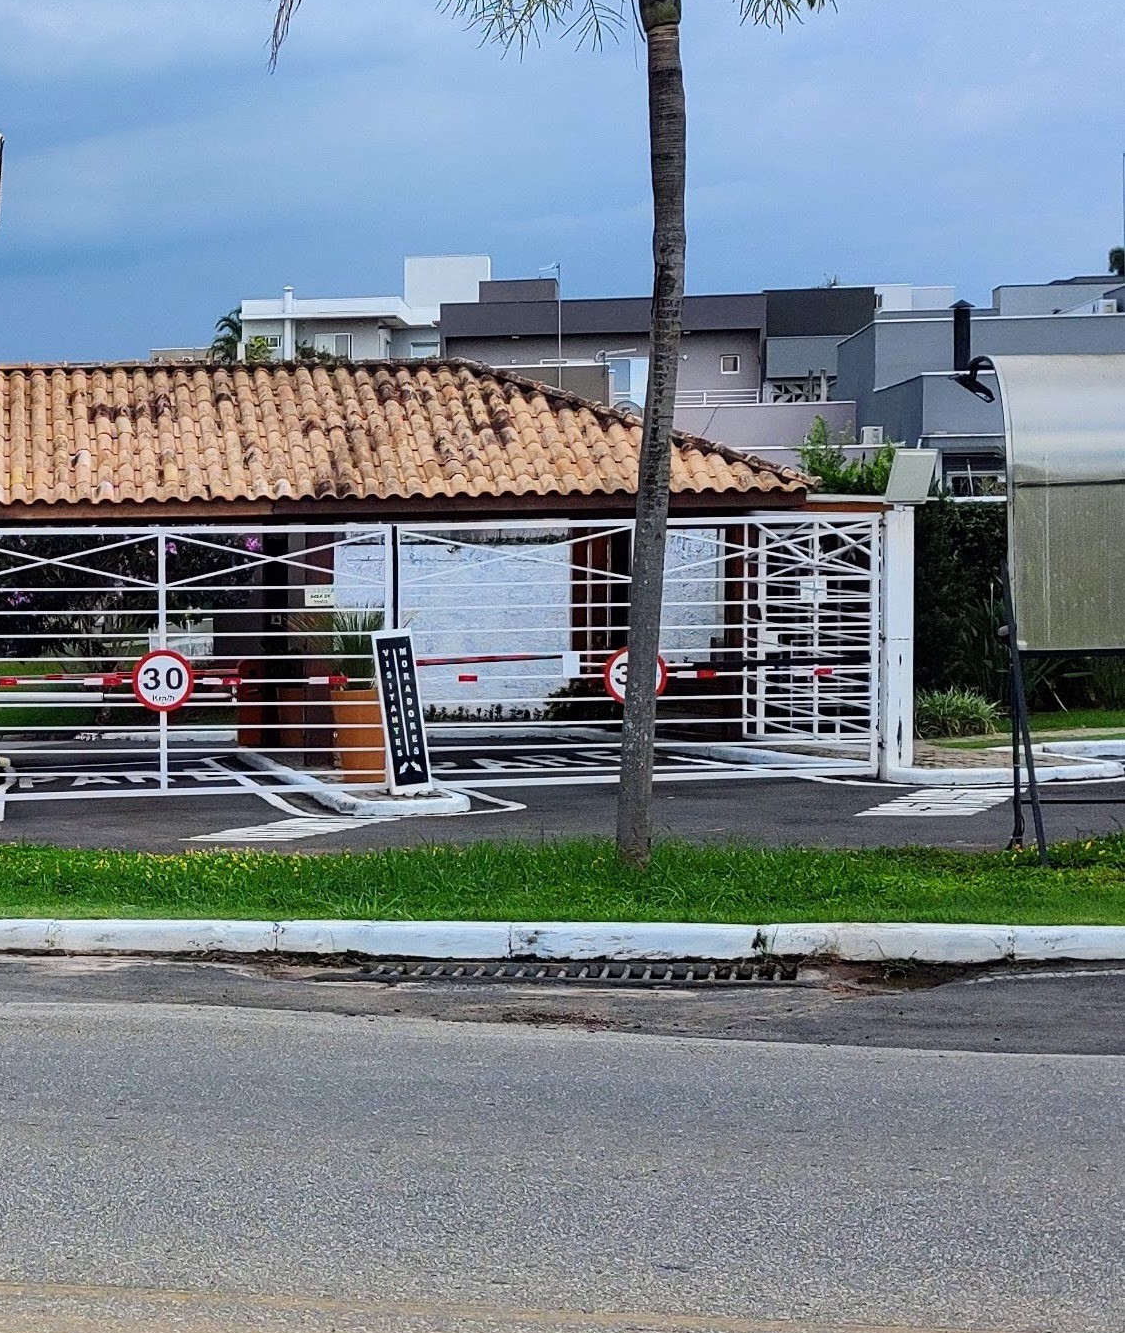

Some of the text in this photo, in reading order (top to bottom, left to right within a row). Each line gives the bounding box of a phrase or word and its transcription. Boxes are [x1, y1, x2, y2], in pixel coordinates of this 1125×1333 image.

[143, 667, 183, 690] 30
[381, 649, 404, 758] VISITANTES
[398, 646, 420, 756] MORADORES
